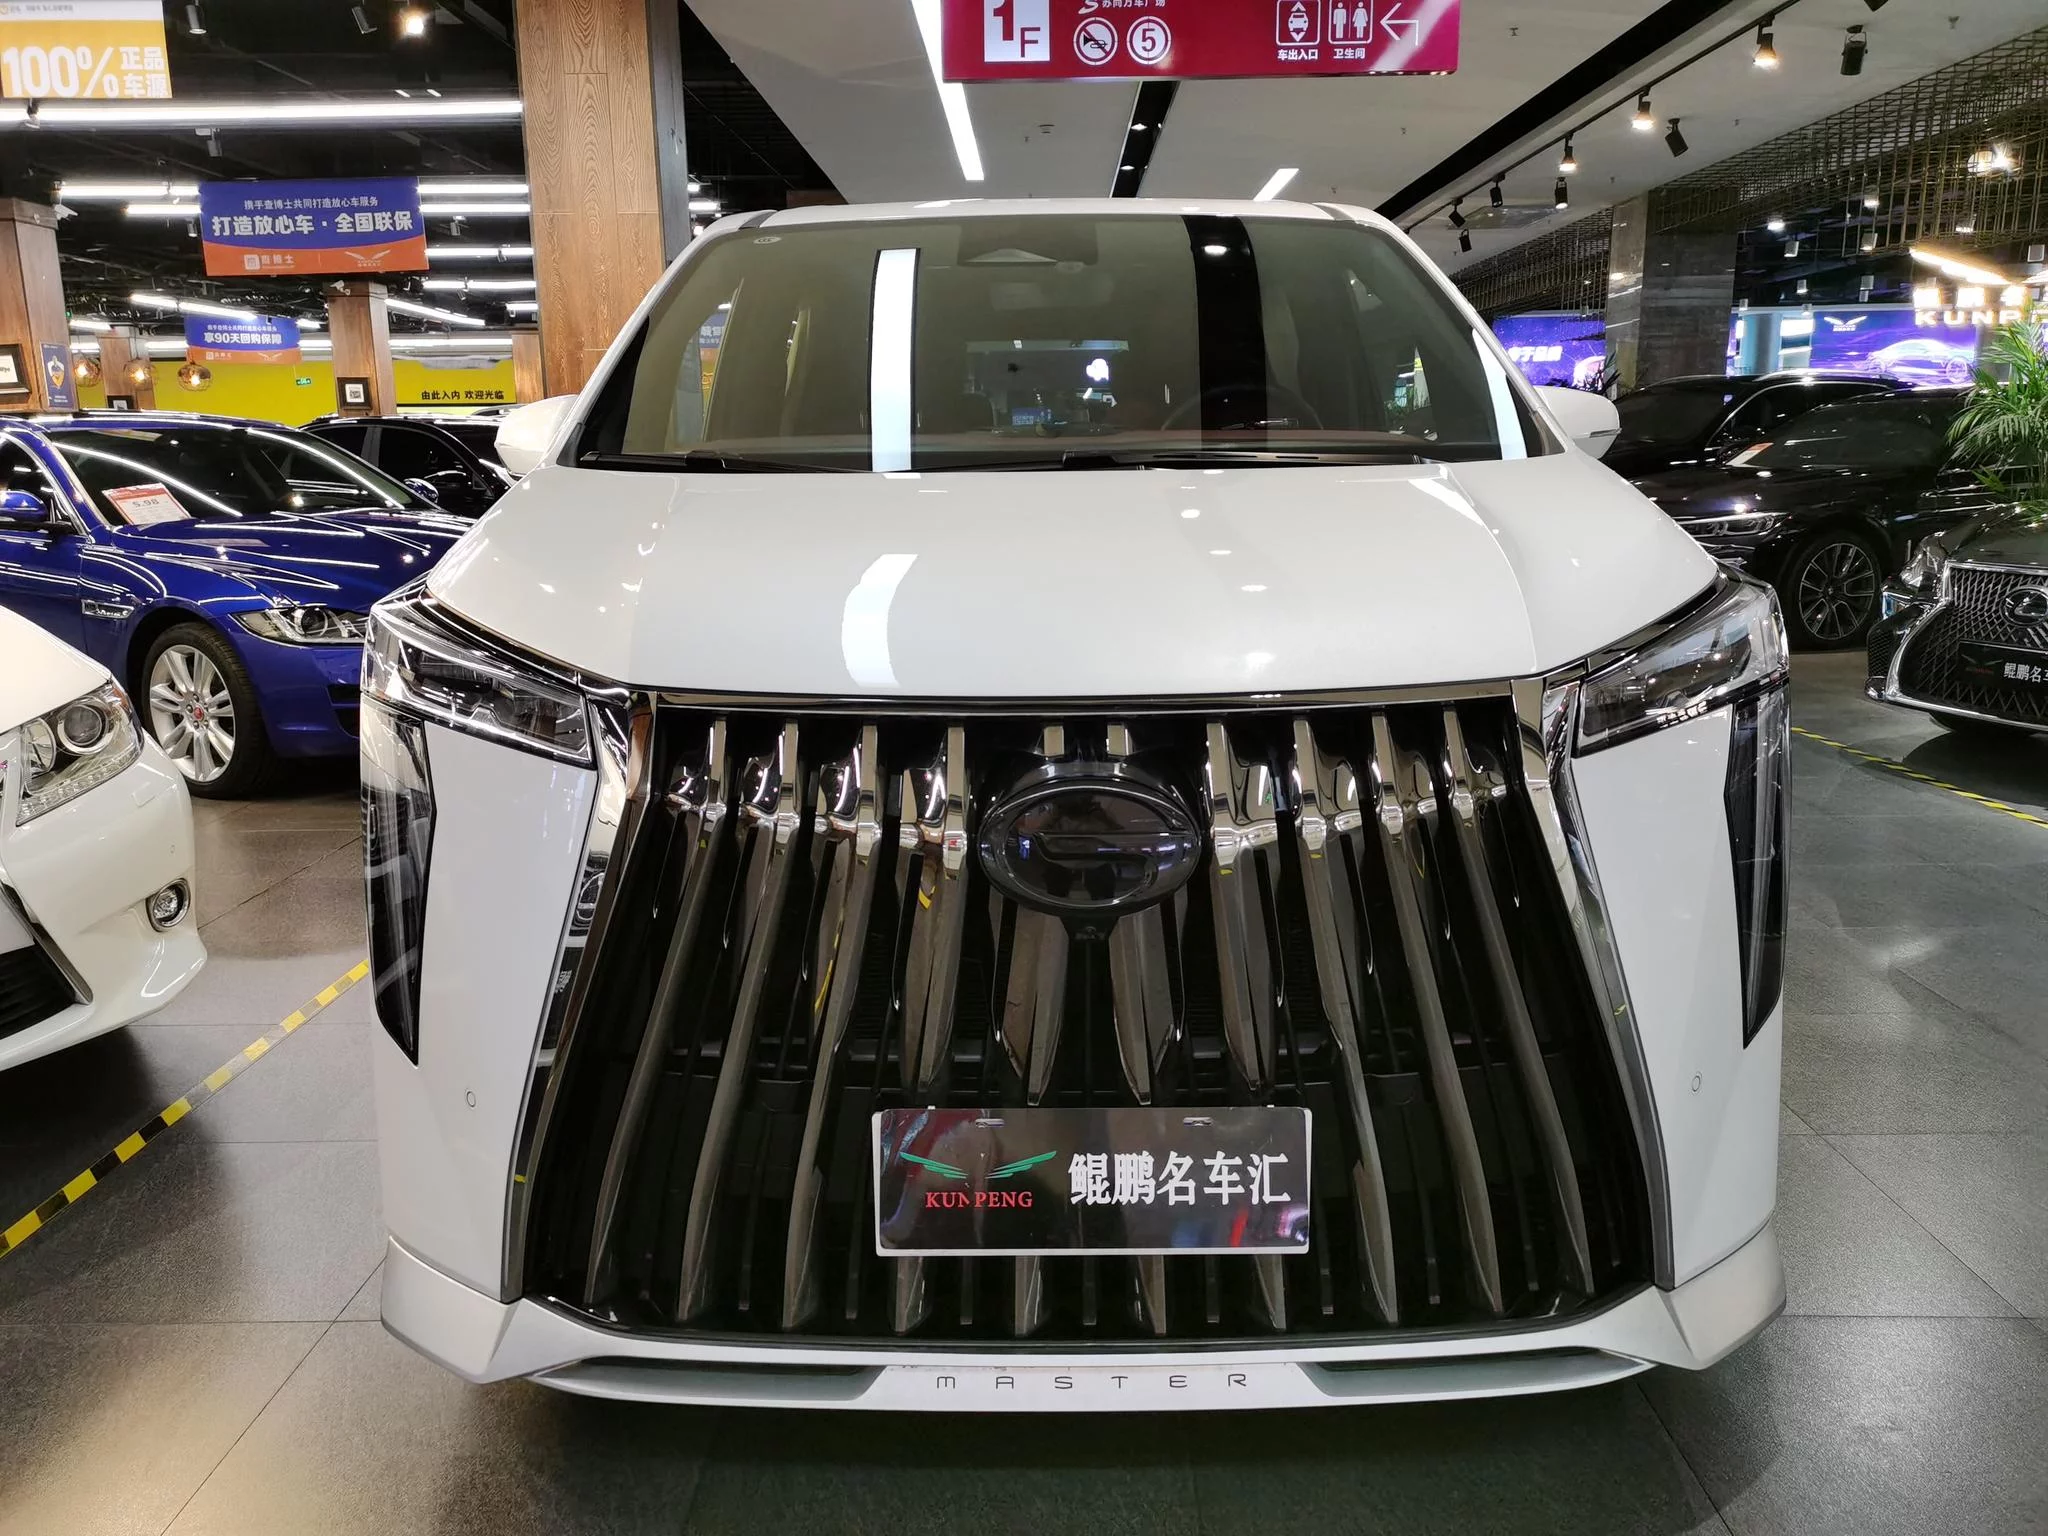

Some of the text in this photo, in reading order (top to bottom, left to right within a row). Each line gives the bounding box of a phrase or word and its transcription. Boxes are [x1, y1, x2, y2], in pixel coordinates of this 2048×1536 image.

[1141, 28, 1156, 53] 5
[120, 47, 165, 70] 正品
[1277, 49, 1318, 61] 车出入口
[1333, 48, 1366, 60] 卫生间
[3, 46, 119, 98] 100%
[123, 73, 169, 98] 车源
[421, 390, 504, 400] 由此入内 欢迎光临
[1068, 1150, 1292, 1207] 鲲鹏名车汇
[936, 1373, 1248, 1390] MASTER
